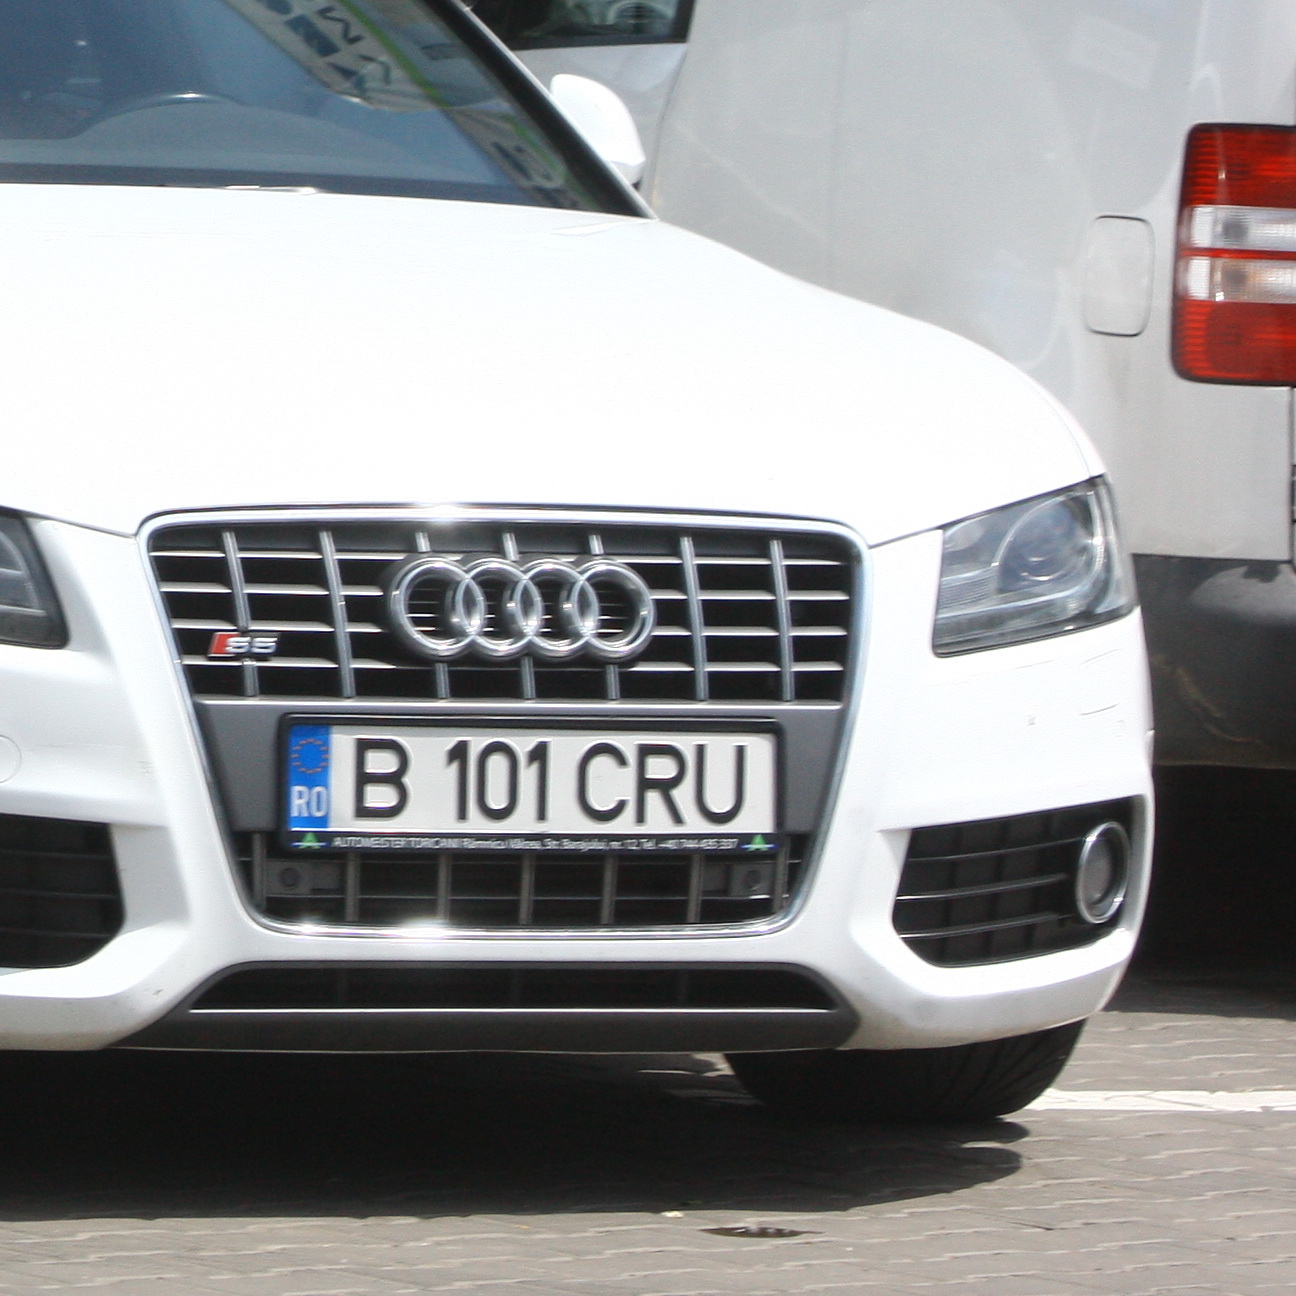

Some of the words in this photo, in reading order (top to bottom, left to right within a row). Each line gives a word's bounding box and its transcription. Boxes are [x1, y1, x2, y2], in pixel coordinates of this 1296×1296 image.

[290, 785, 328, 818] RO
[354, 738, 407, 819] B
[446, 739, 549, 822] 101
[578, 742, 749, 824] CRU
